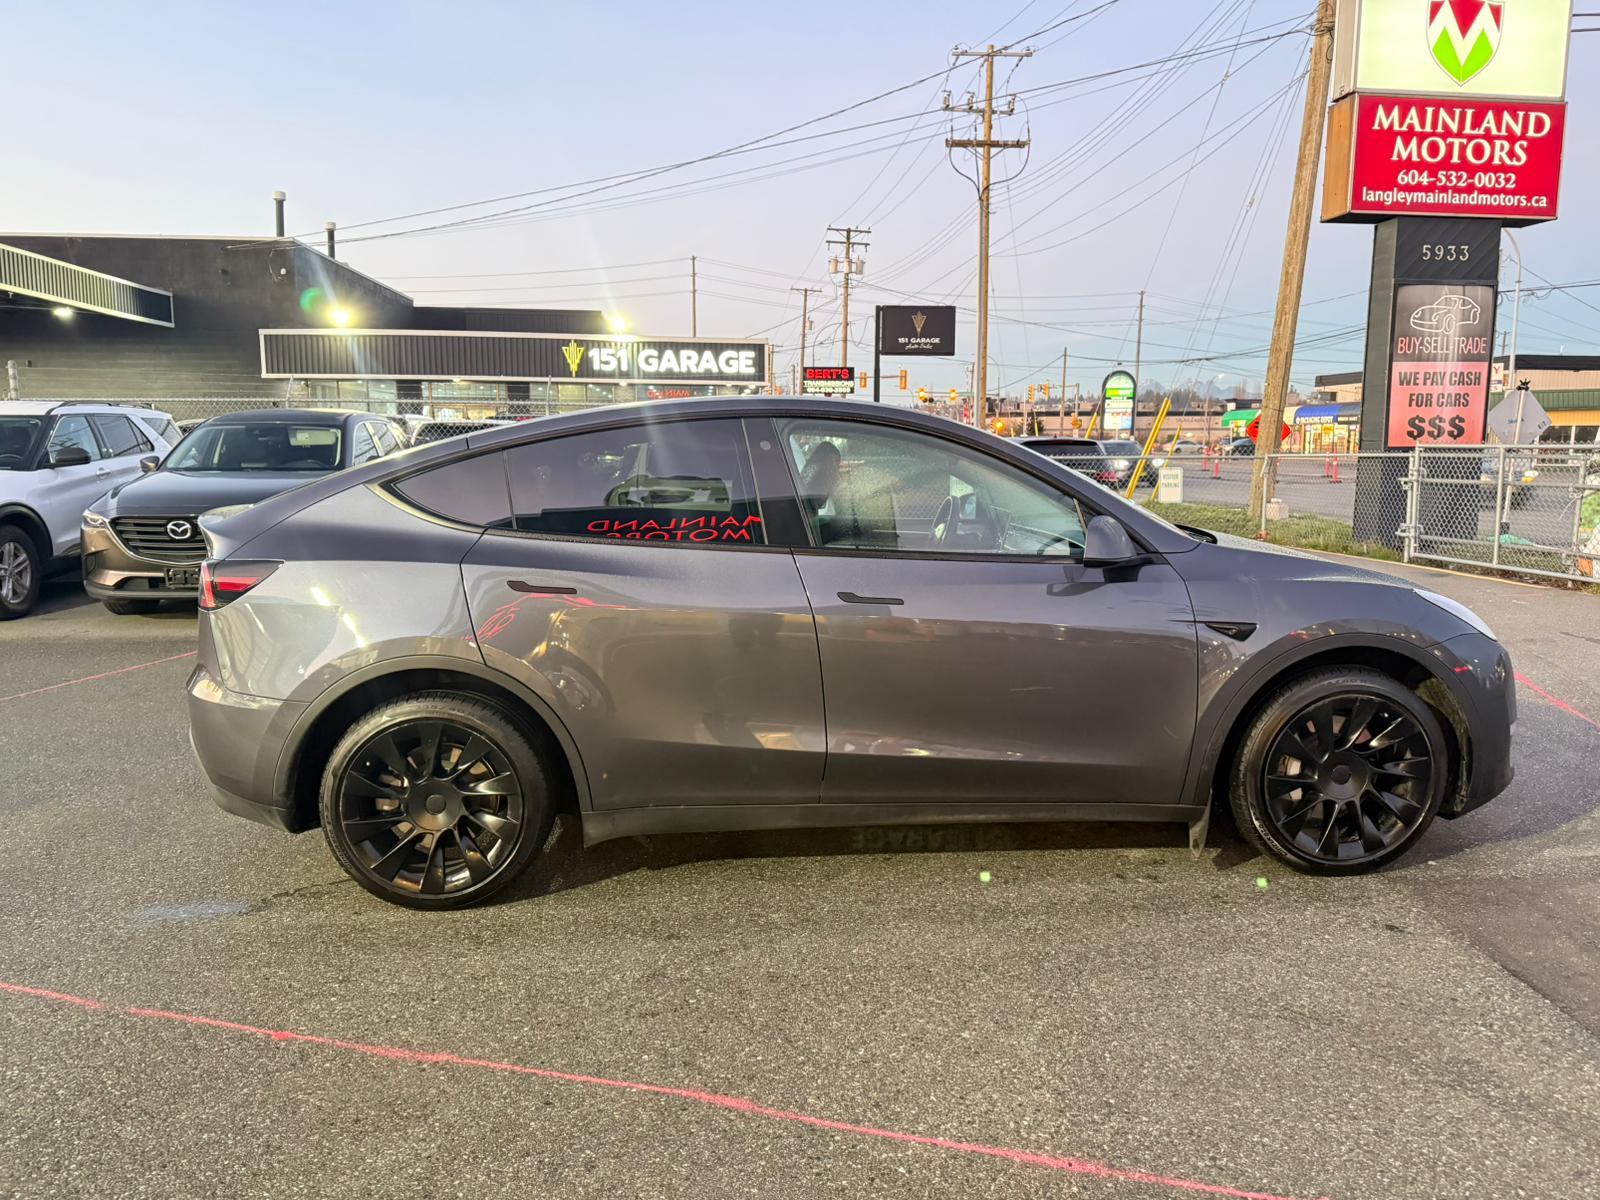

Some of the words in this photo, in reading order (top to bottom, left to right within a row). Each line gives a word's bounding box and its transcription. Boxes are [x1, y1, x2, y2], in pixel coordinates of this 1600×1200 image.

[1371, 104, 1551, 138] MAINLAND
[1390, 136, 1528, 166] MOTORS
[1397, 170, 1516, 189] 604-532-0032
[1362, 187, 1548, 208] langleymainlandmotors.ca
[1422, 244, 1470, 261] 5933
[588, 347, 628, 371] 151
[638, 349, 756, 374] GARAGE
[806, 368, 849, 379] BERT'S
[1398, 371, 1419, 386] WE
[1422, 371, 1446, 386] PAY
[1449, 371, 1482, 386] CASH
[1408, 392, 1433, 407] FOR
[1436, 392, 1470, 407] CARS
[1406, 414, 1466, 440] $$$
